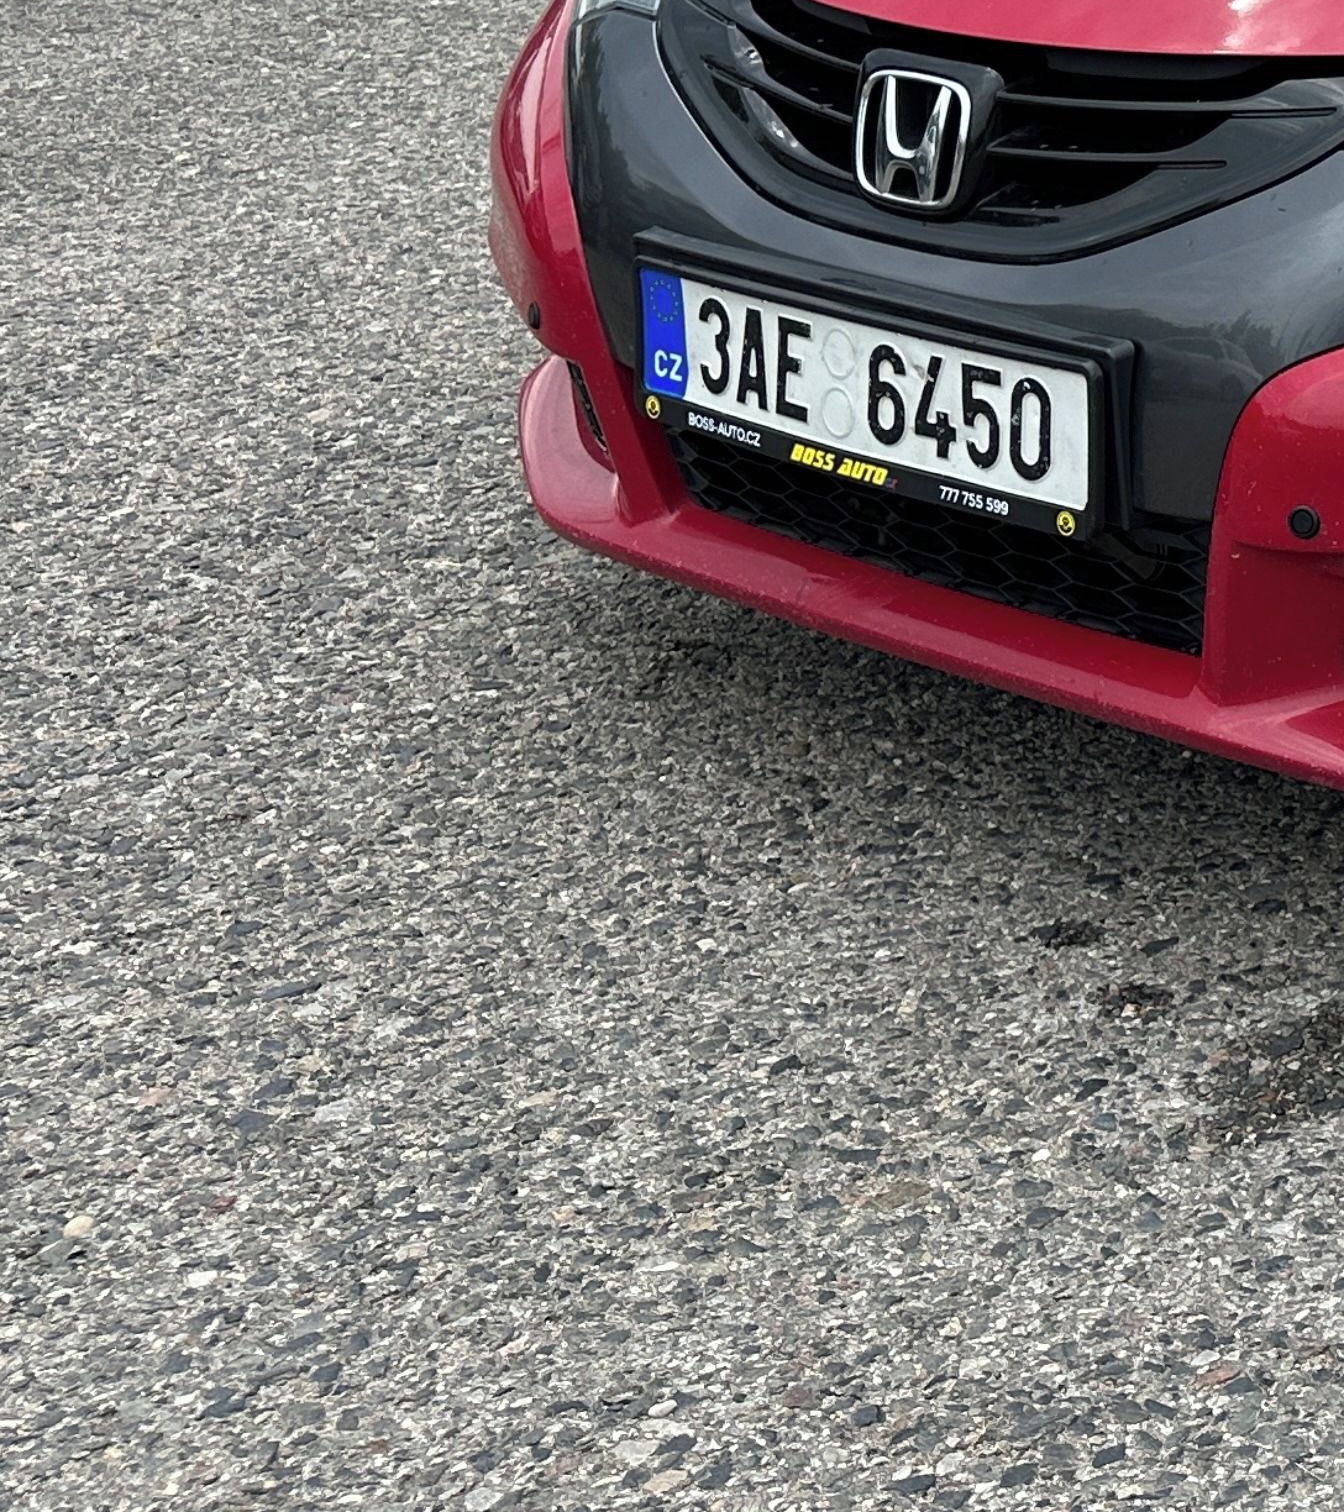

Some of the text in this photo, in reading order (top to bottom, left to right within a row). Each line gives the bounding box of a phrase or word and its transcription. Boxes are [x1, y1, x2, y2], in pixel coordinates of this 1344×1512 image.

[654, 349, 683, 382] CZ
[698, 297, 1052, 482] 3AE 6450
[688, 411, 761, 447] BOSS-AUTO.CZ
[790, 443, 889, 486] BOSS AUTO
[939, 485, 1009, 516] 777 755 599
